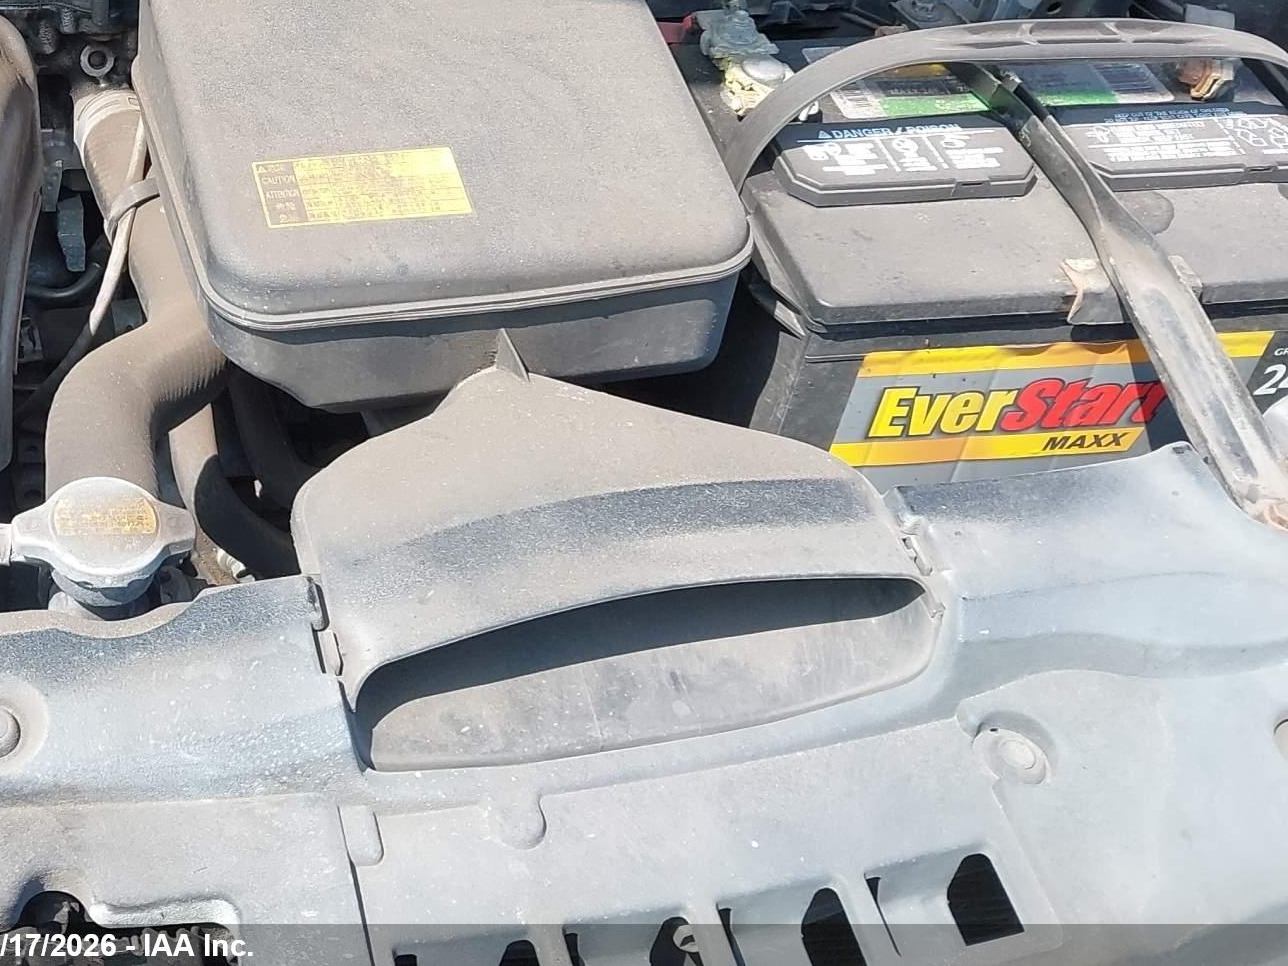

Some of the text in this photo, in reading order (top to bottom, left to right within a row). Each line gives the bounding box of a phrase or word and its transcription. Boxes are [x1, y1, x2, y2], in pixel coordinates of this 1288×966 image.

[831, 127, 890, 139] DANGER
[866, 377, 1170, 440] EverStart
[1042, 431, 1131, 452] MAXX
